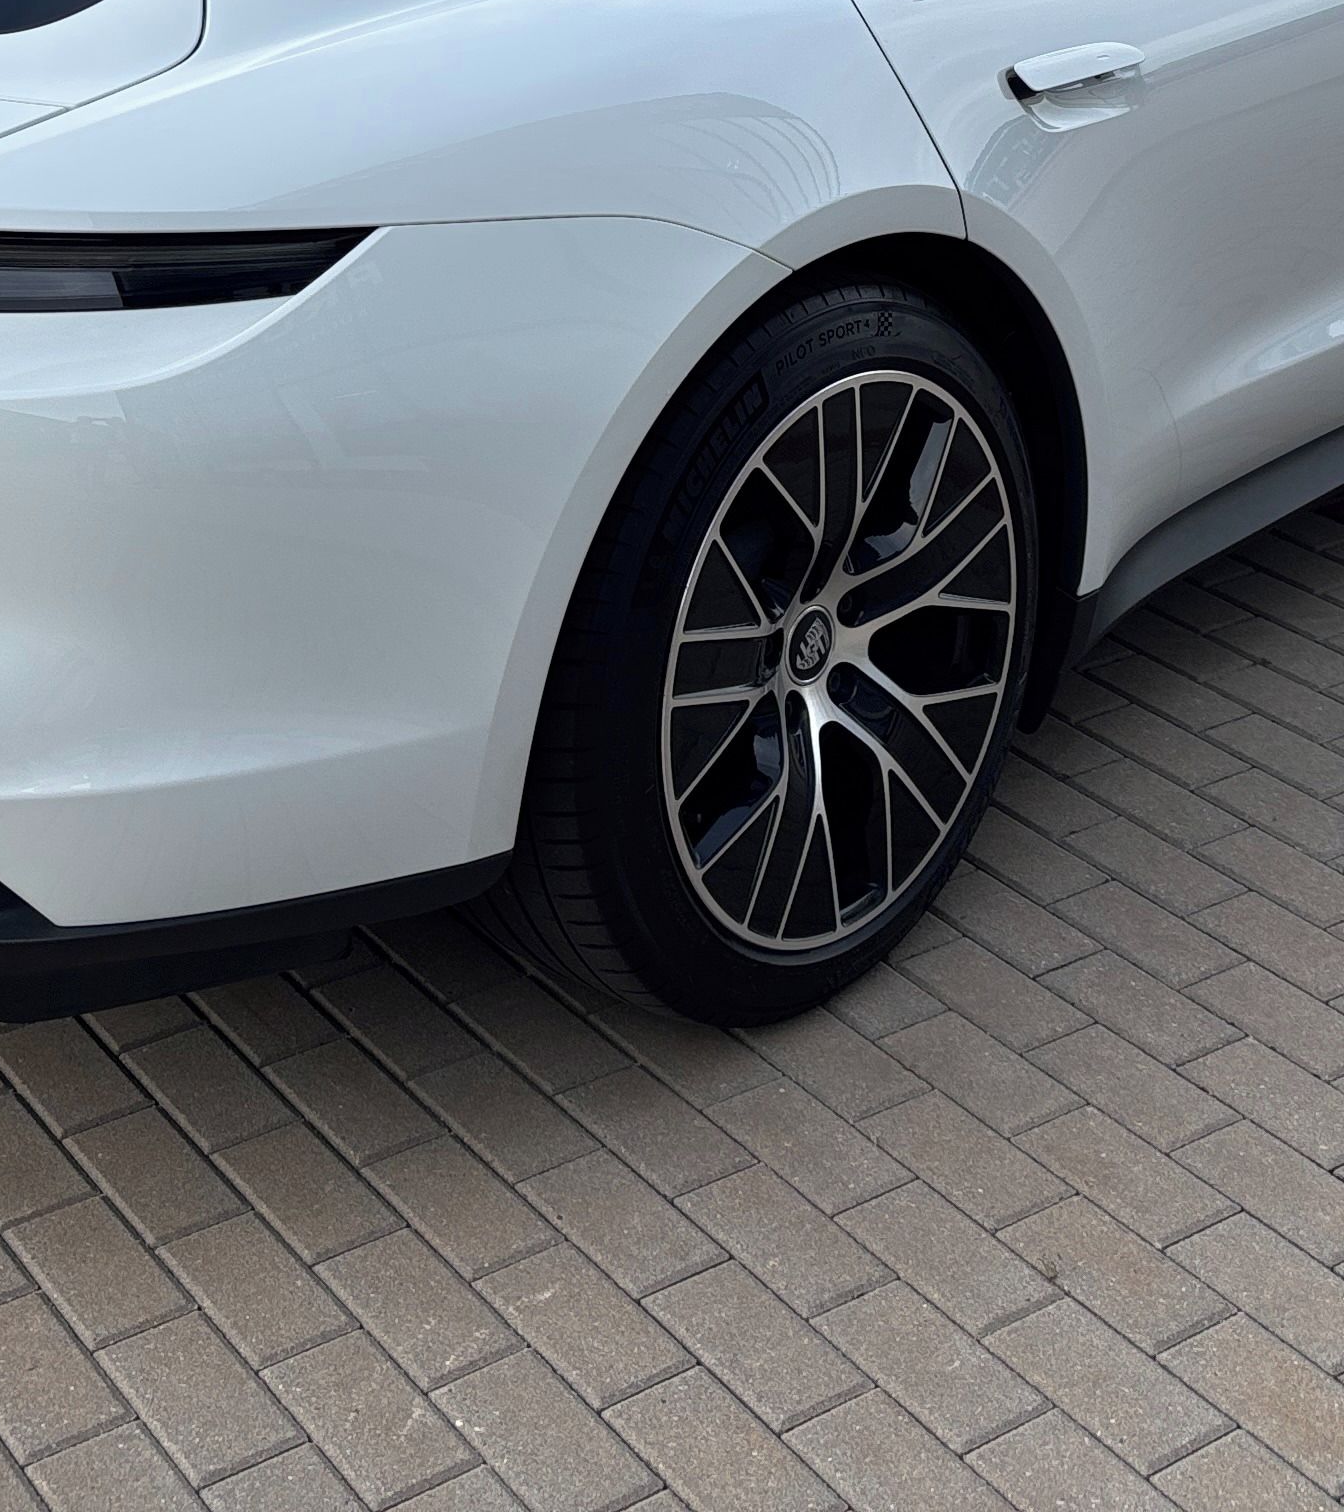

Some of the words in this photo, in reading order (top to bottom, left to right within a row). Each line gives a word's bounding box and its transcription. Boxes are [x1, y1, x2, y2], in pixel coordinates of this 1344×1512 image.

[775, 339, 814, 375] PILOT
[818, 319, 862, 347] SPORT
[660, 380, 764, 545] MICHELIN
